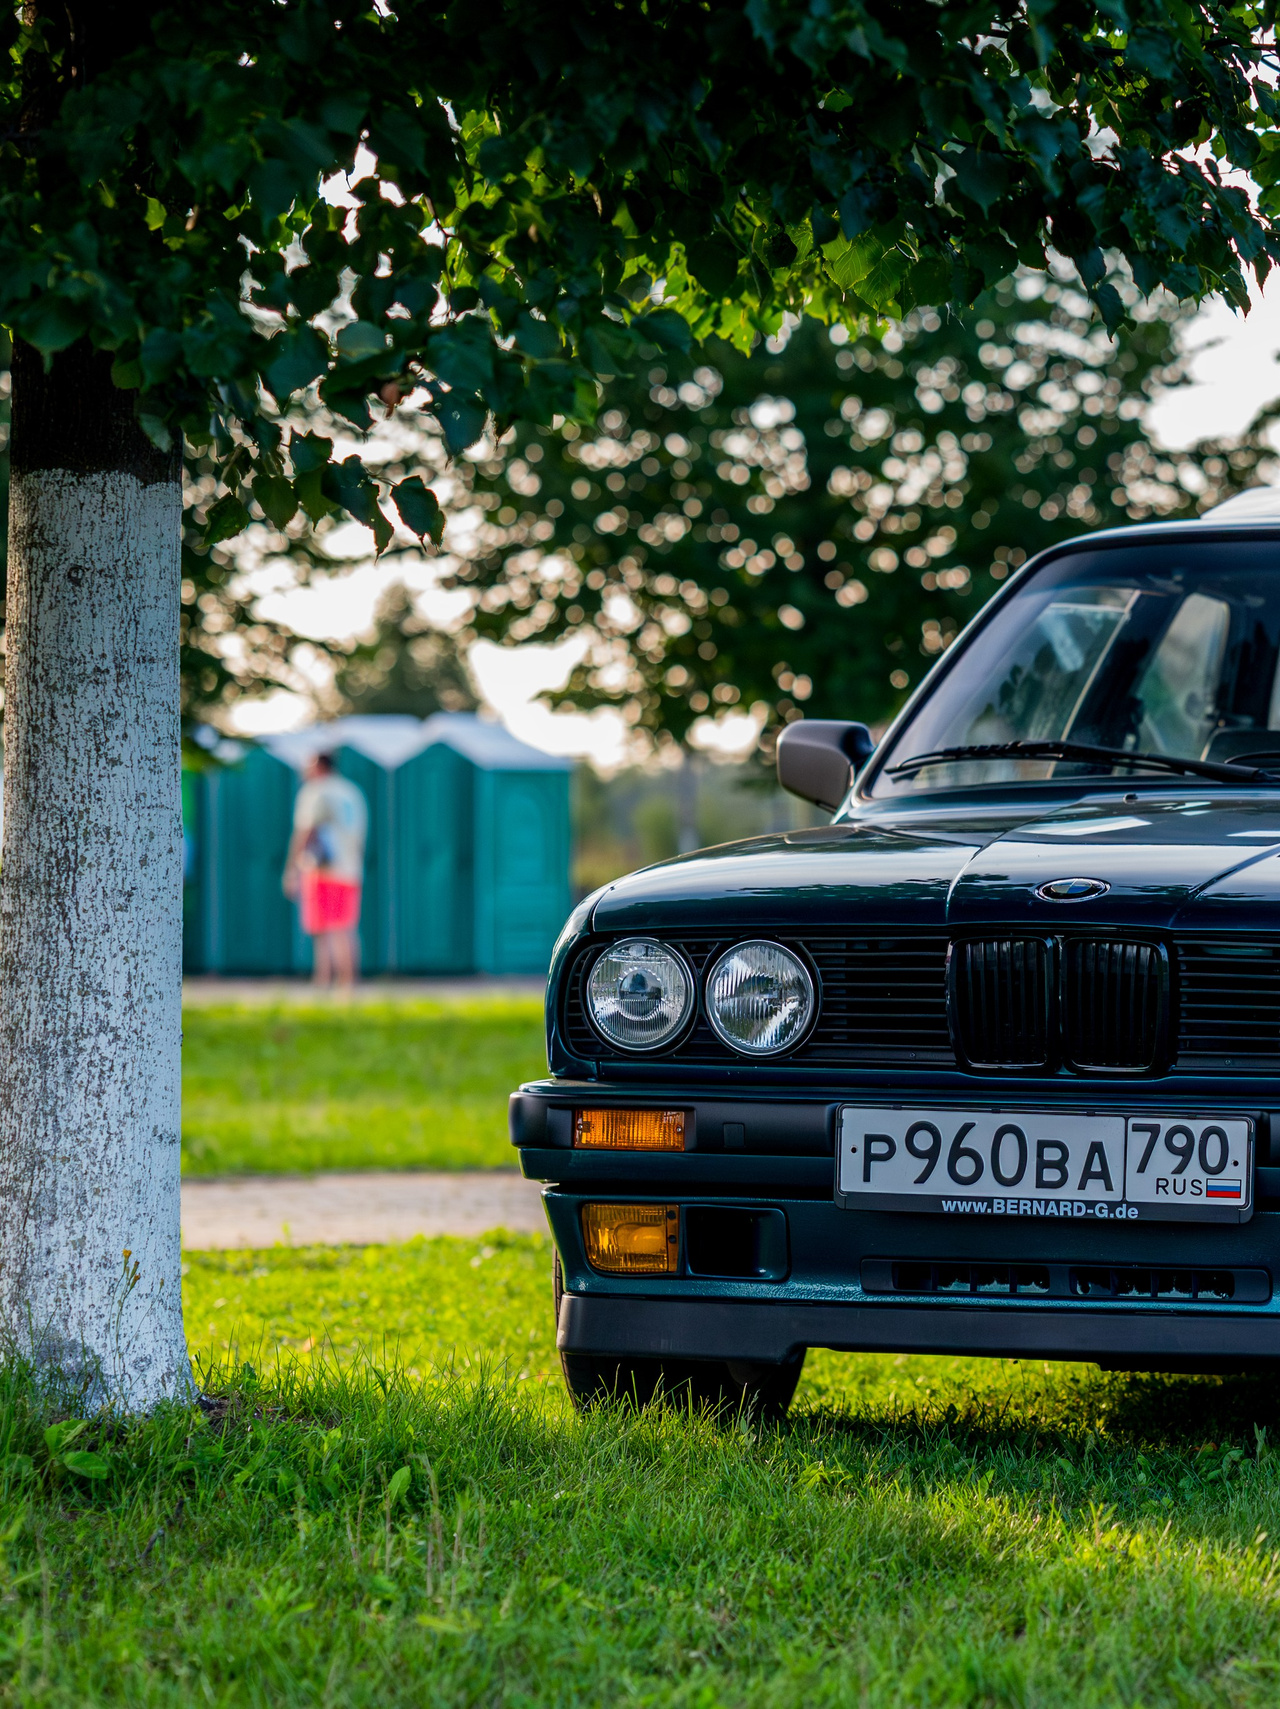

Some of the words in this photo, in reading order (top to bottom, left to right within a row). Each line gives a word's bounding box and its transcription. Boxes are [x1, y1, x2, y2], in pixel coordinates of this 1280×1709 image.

[863, 1120, 1115, 1192] Р960ВА
[1131, 1123, 1230, 1176] 790
[1155, 1177, 1203, 1196] RUS
[941, 1198, 1139, 1219] www.BERNARD-G.de
